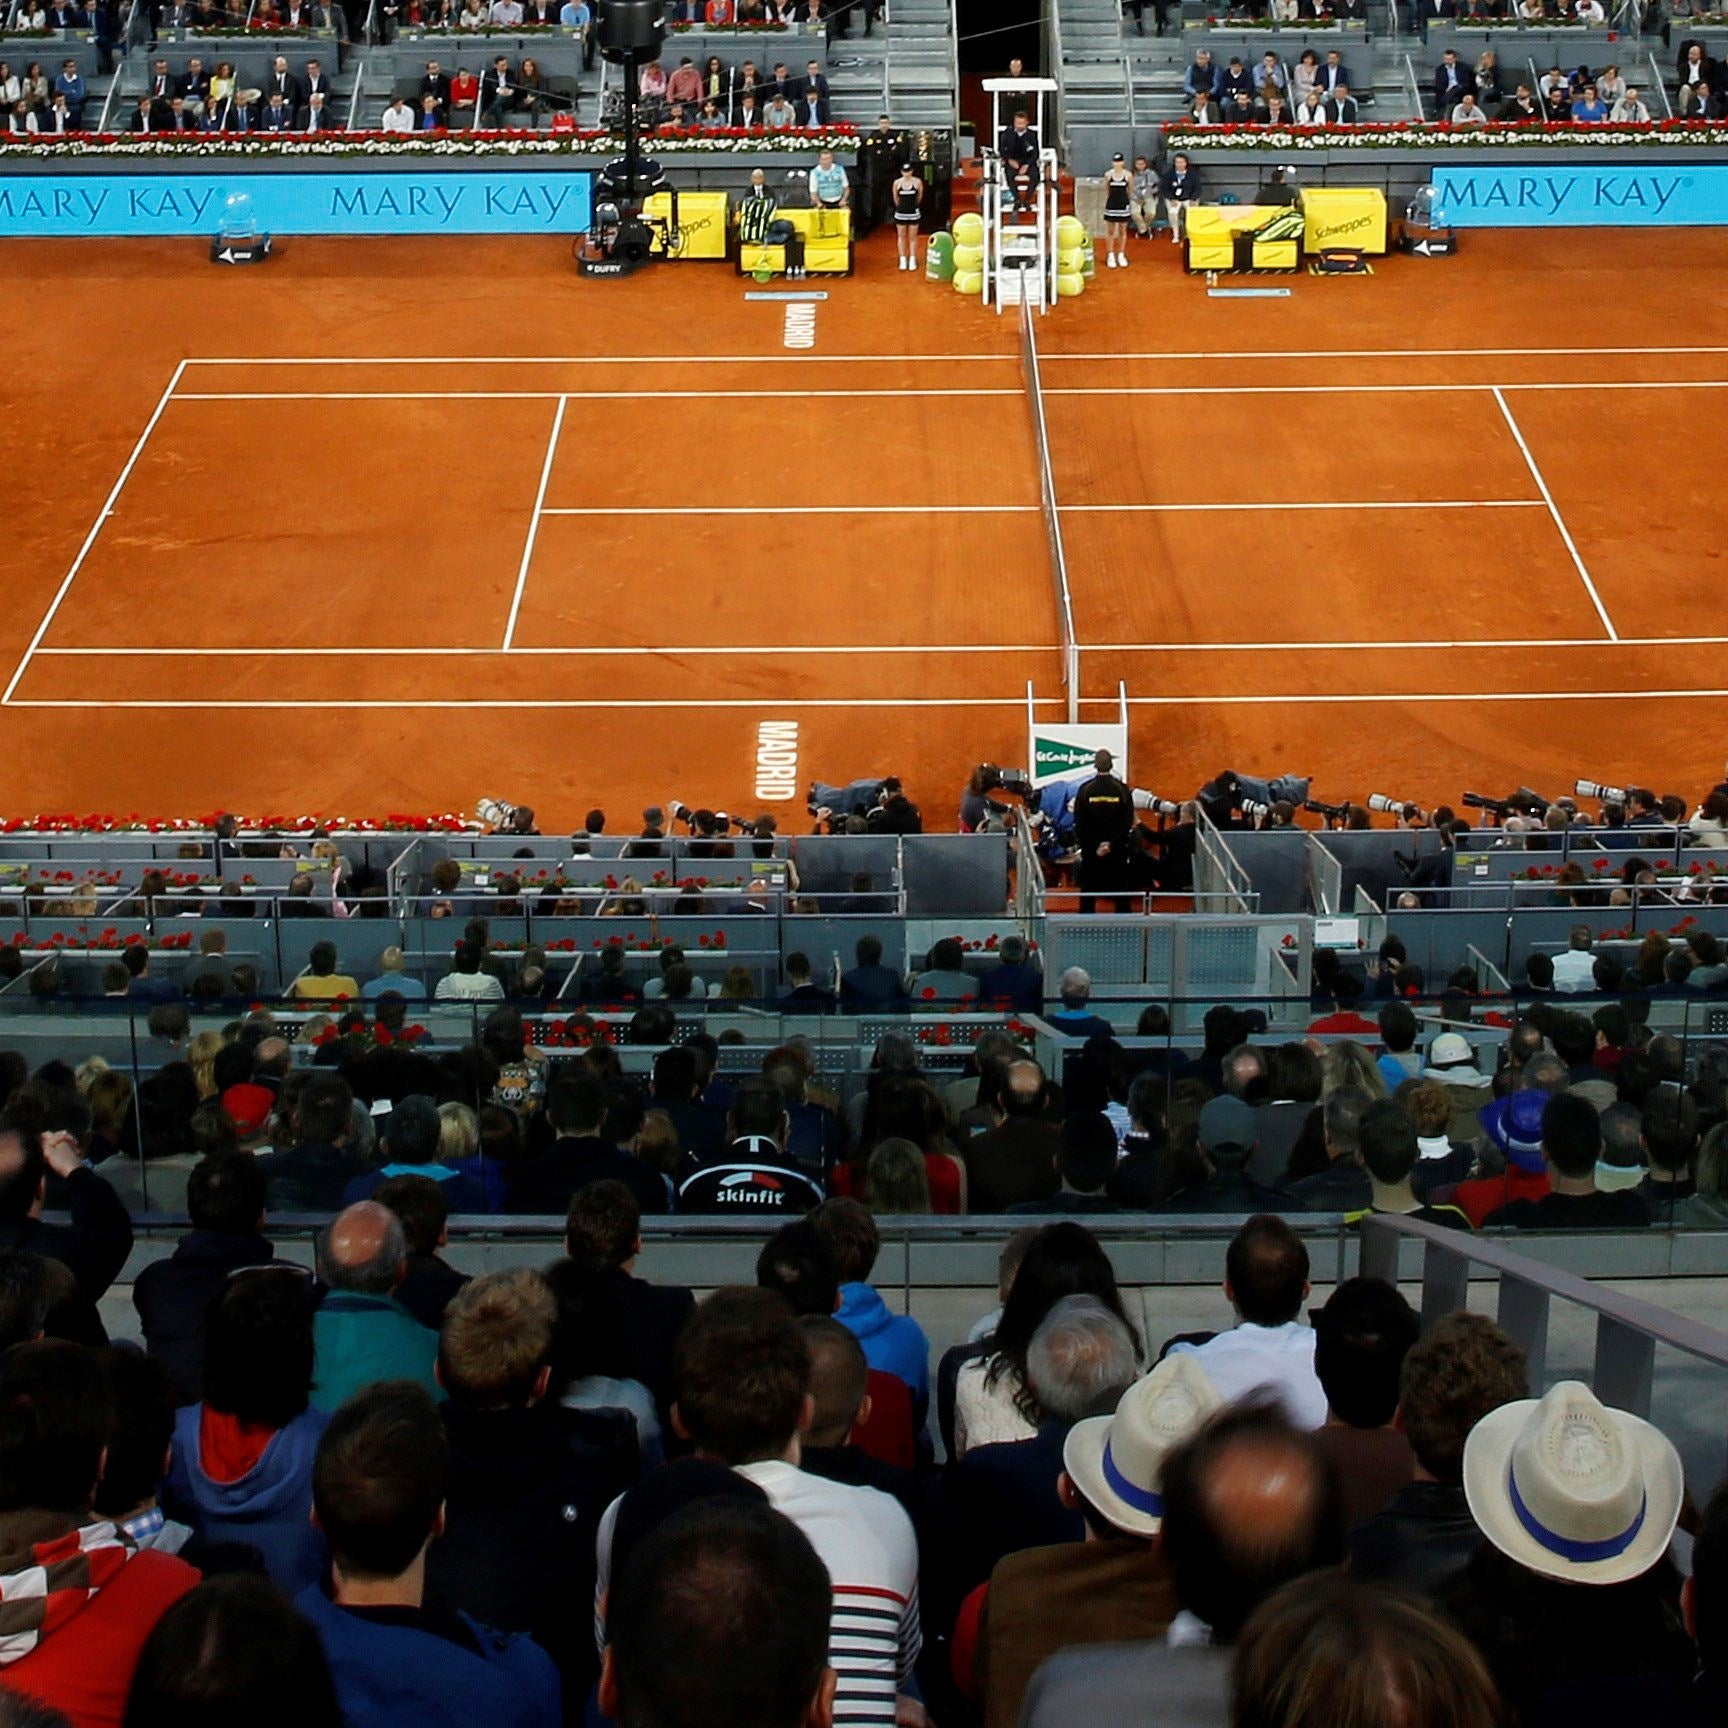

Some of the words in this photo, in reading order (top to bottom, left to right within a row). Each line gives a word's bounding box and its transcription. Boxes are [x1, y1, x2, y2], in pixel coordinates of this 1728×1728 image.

[129, 187, 216, 225] KAY
[330, 185, 466, 223] MARY
[484, 185, 570, 223] KAY
[1441, 177, 1577, 215] MARY
[1593, 176, 1682, 215] KAY
[1313, 212, 1375, 242] Schweppes
[593, 263, 622, 274] DUFRY
[755, 720, 799, 800] MADRID
[716, 1187, 785, 1206] skinfit
